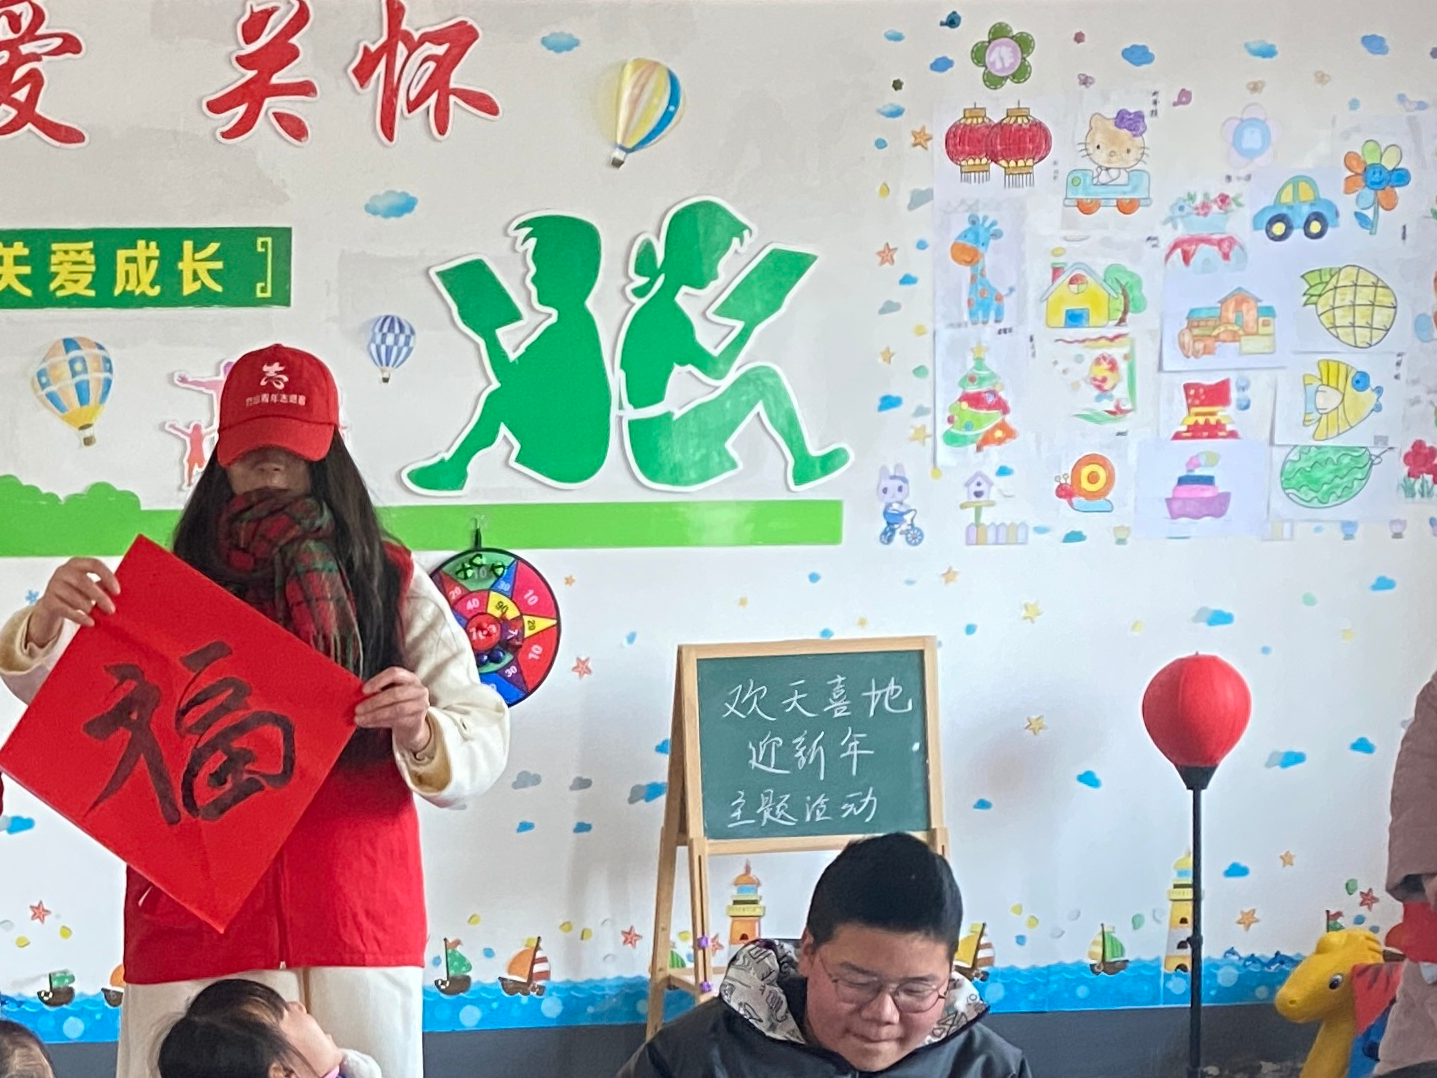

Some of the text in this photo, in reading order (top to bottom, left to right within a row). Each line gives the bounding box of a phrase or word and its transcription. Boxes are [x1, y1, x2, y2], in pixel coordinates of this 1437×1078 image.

[205, 0, 500, 143] 关怀
[523, 588, 540, 606] 10
[527, 643, 544, 661] 10
[721, 674, 913, 722] 欢天喜地
[84, 640, 297, 826] 福
[747, 726, 875, 781] 迎新年
[726, 786, 879, 829] 主题活动
